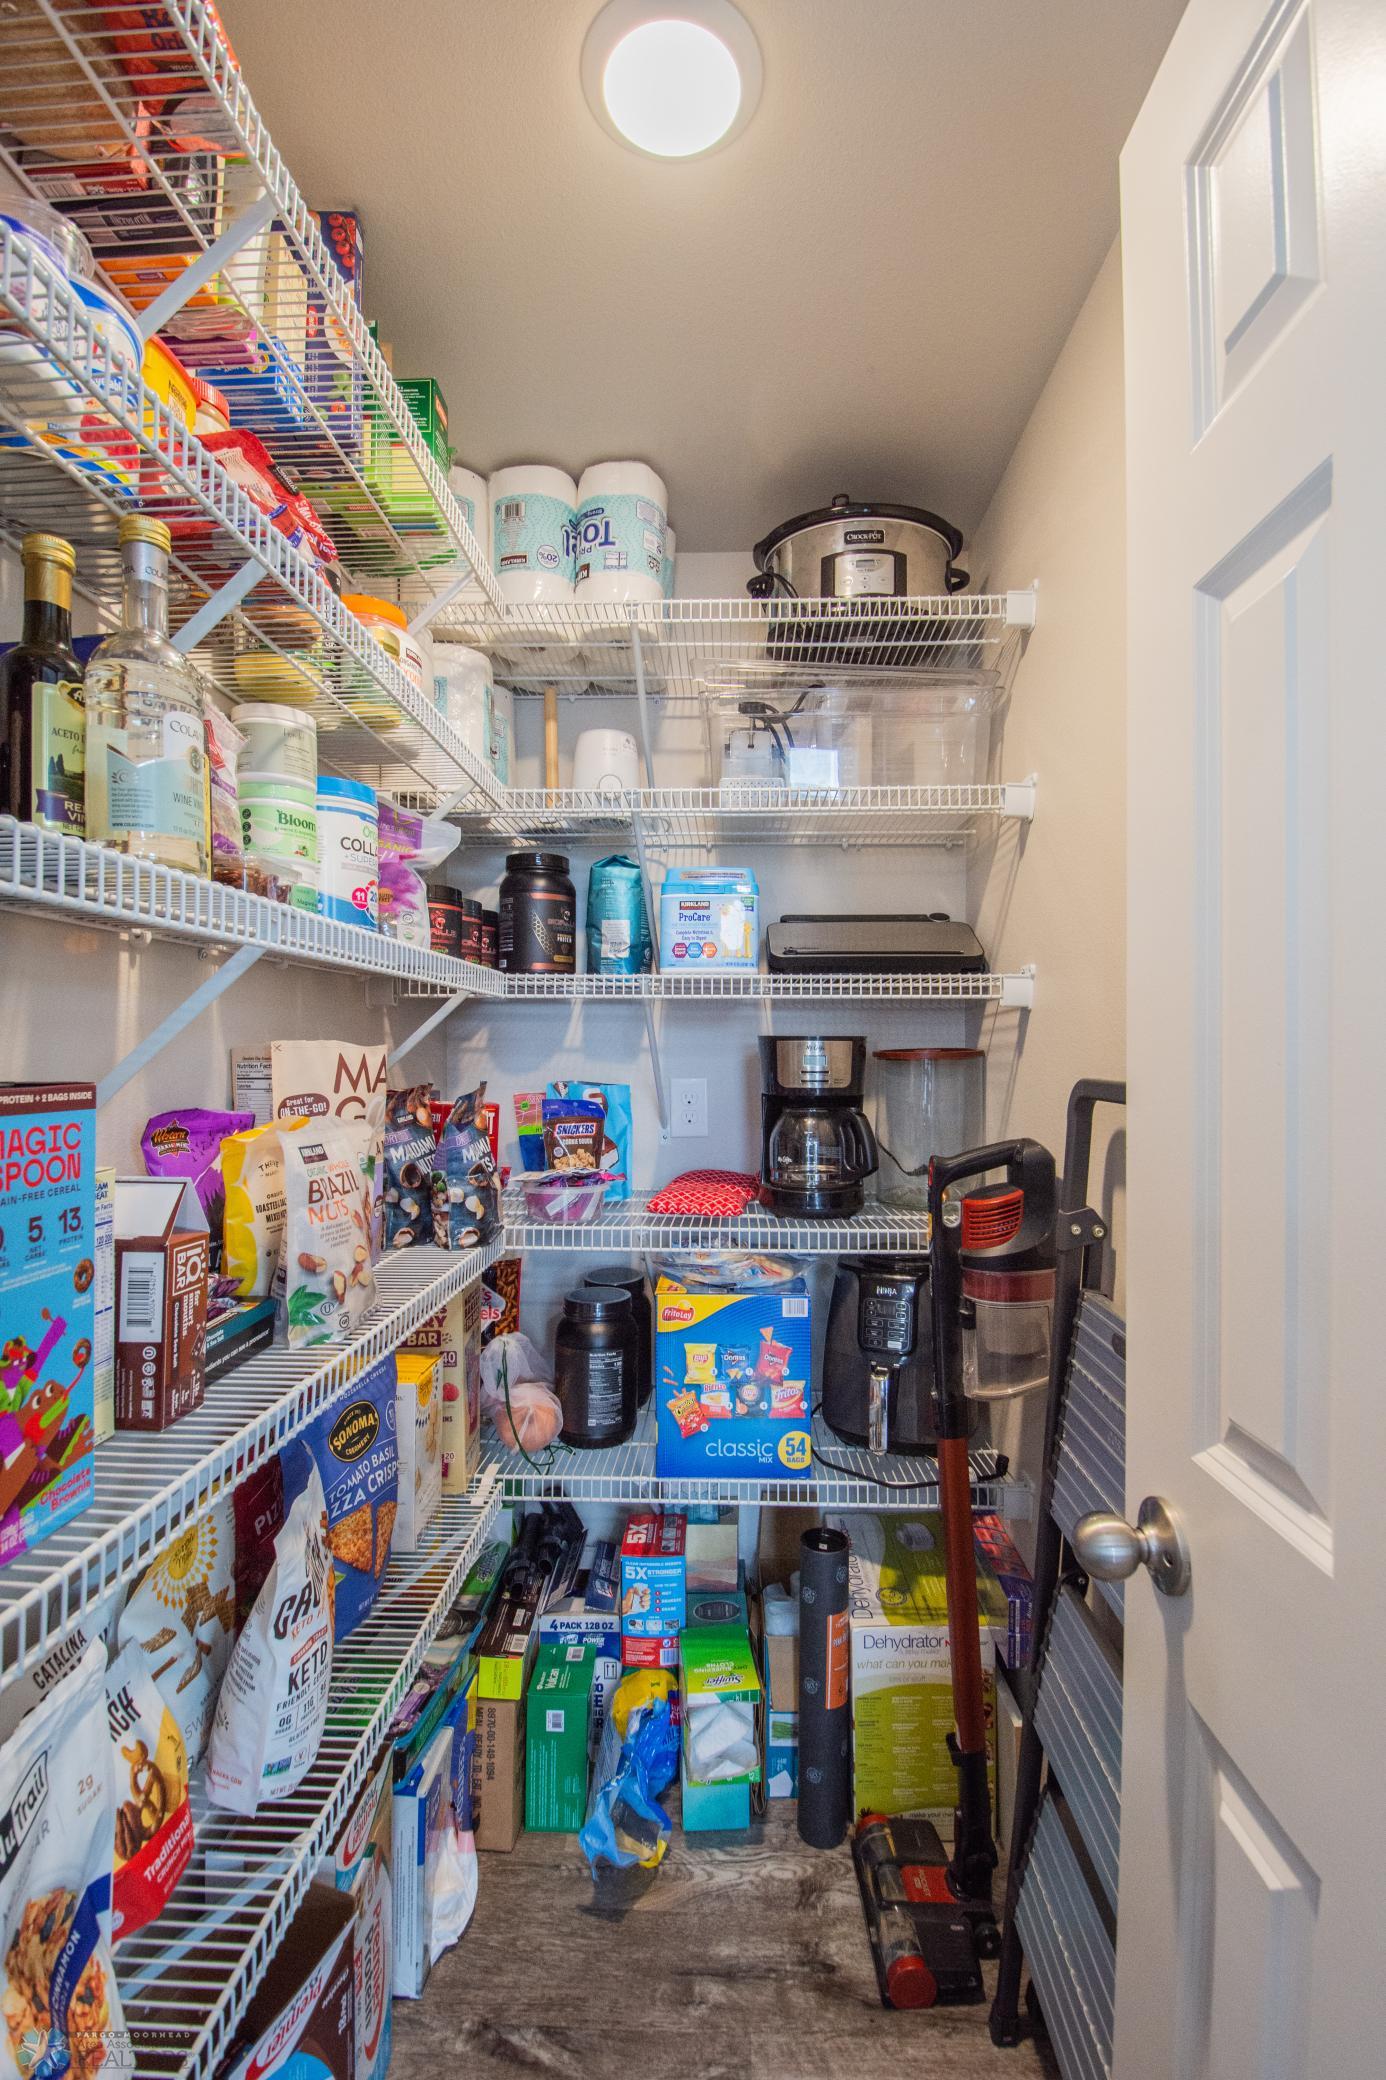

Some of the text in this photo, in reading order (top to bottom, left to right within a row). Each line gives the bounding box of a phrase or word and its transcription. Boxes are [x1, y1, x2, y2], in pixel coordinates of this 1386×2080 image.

[51, 726, 81, 742] ACETO
[172, 790, 194, 807] WINE
[277, 809, 317, 833] Bloom
[678, 912, 711, 922] ProCare
[47, 1092, 68, 1102] BAGS
[69, 1090, 93, 1101] INSIDE
[286, 1096, 314, 1105] Great for
[556, 1123, 595, 1136] SNICKERS
[48, 1184, 82, 1198] CEREAL
[308, 1198, 350, 1225] NUTS
[175, 1252, 187, 1290] BAR
[408, 1333, 439, 1346] BAR
[332, 1411, 376, 1451] SONOMA
[705, 1439, 773, 1458] classic
[785, 1437, 807, 1456] 54
[329, 1445, 395, 1503] TOMATO BASIL
[329, 1487, 367, 1519] ZZA
[625, 1566, 682, 1580] 5X STRONGER
[549, 1619, 615, 1631] 4 PACK 128 OZ
[582, 1636, 606, 1645] POWER
[863, 1634, 945, 1652] Dehydrator
[32, 1628, 88, 1691] CATALINA
[287, 1640, 329, 1697] KETO
[857, 1658, 882, 1670] what
[885, 1660, 908, 1670] can
[909, 1660, 928, 1673] you
[544, 1667, 560, 1690] Vulcan
[704, 1674, 745, 1686] Swiffer
[275, 1685, 312, 1713] FRIENDLY
[143, 1808, 191, 1882] Traditional
[51, 1929, 82, 2006] CINNAMON
